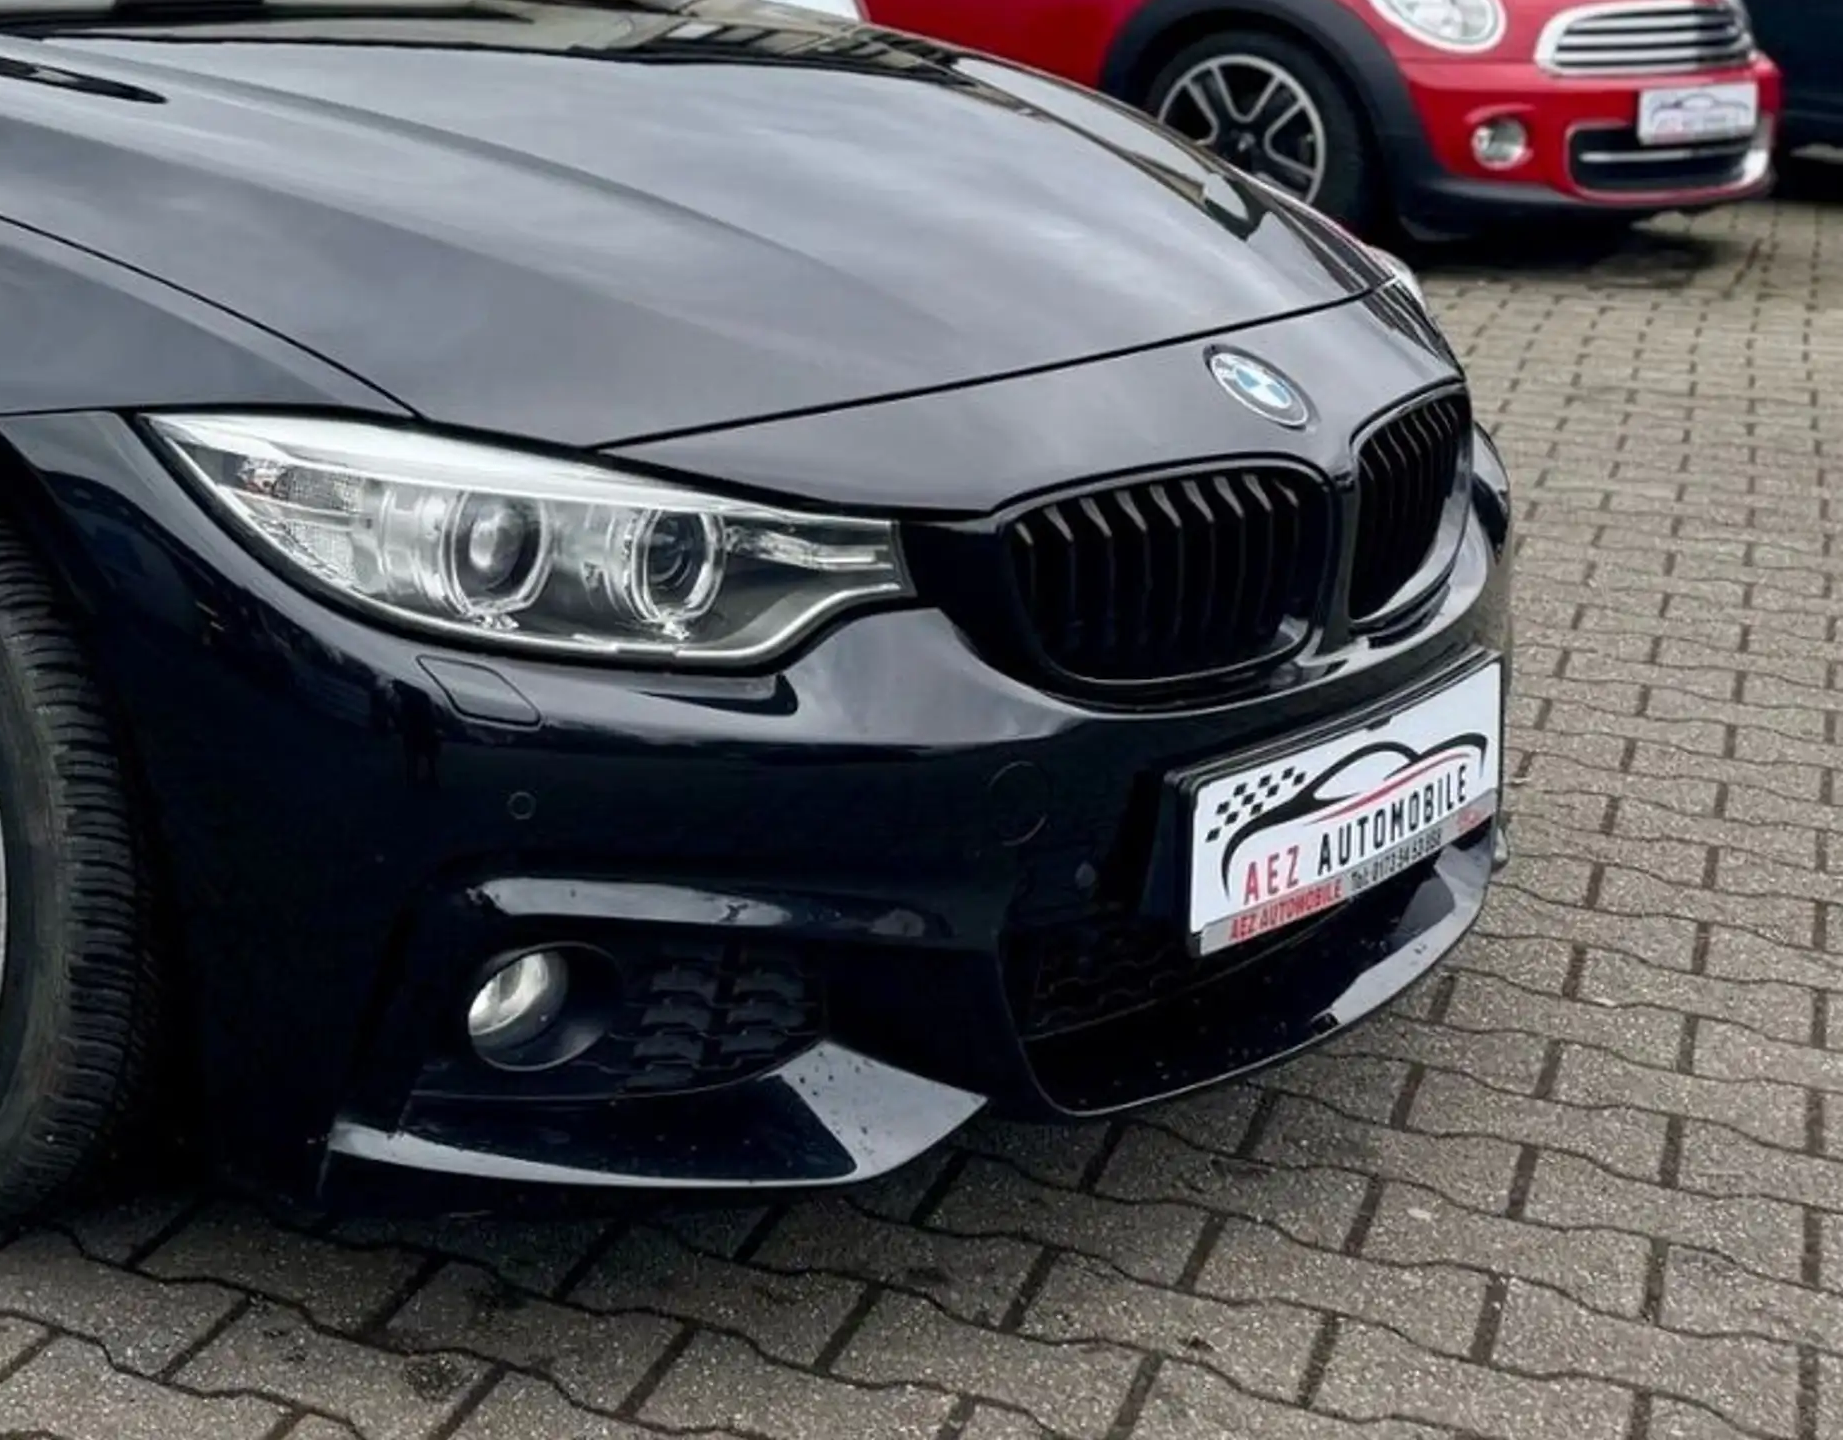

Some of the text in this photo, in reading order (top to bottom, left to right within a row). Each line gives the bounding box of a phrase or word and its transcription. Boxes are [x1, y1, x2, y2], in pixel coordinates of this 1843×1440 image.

[1244, 763, 1468, 906] AEZ AUTOMOBILE
[1231, 913, 1258, 941] AEZ
[1259, 877, 1343, 930] AUTOMOBILE
